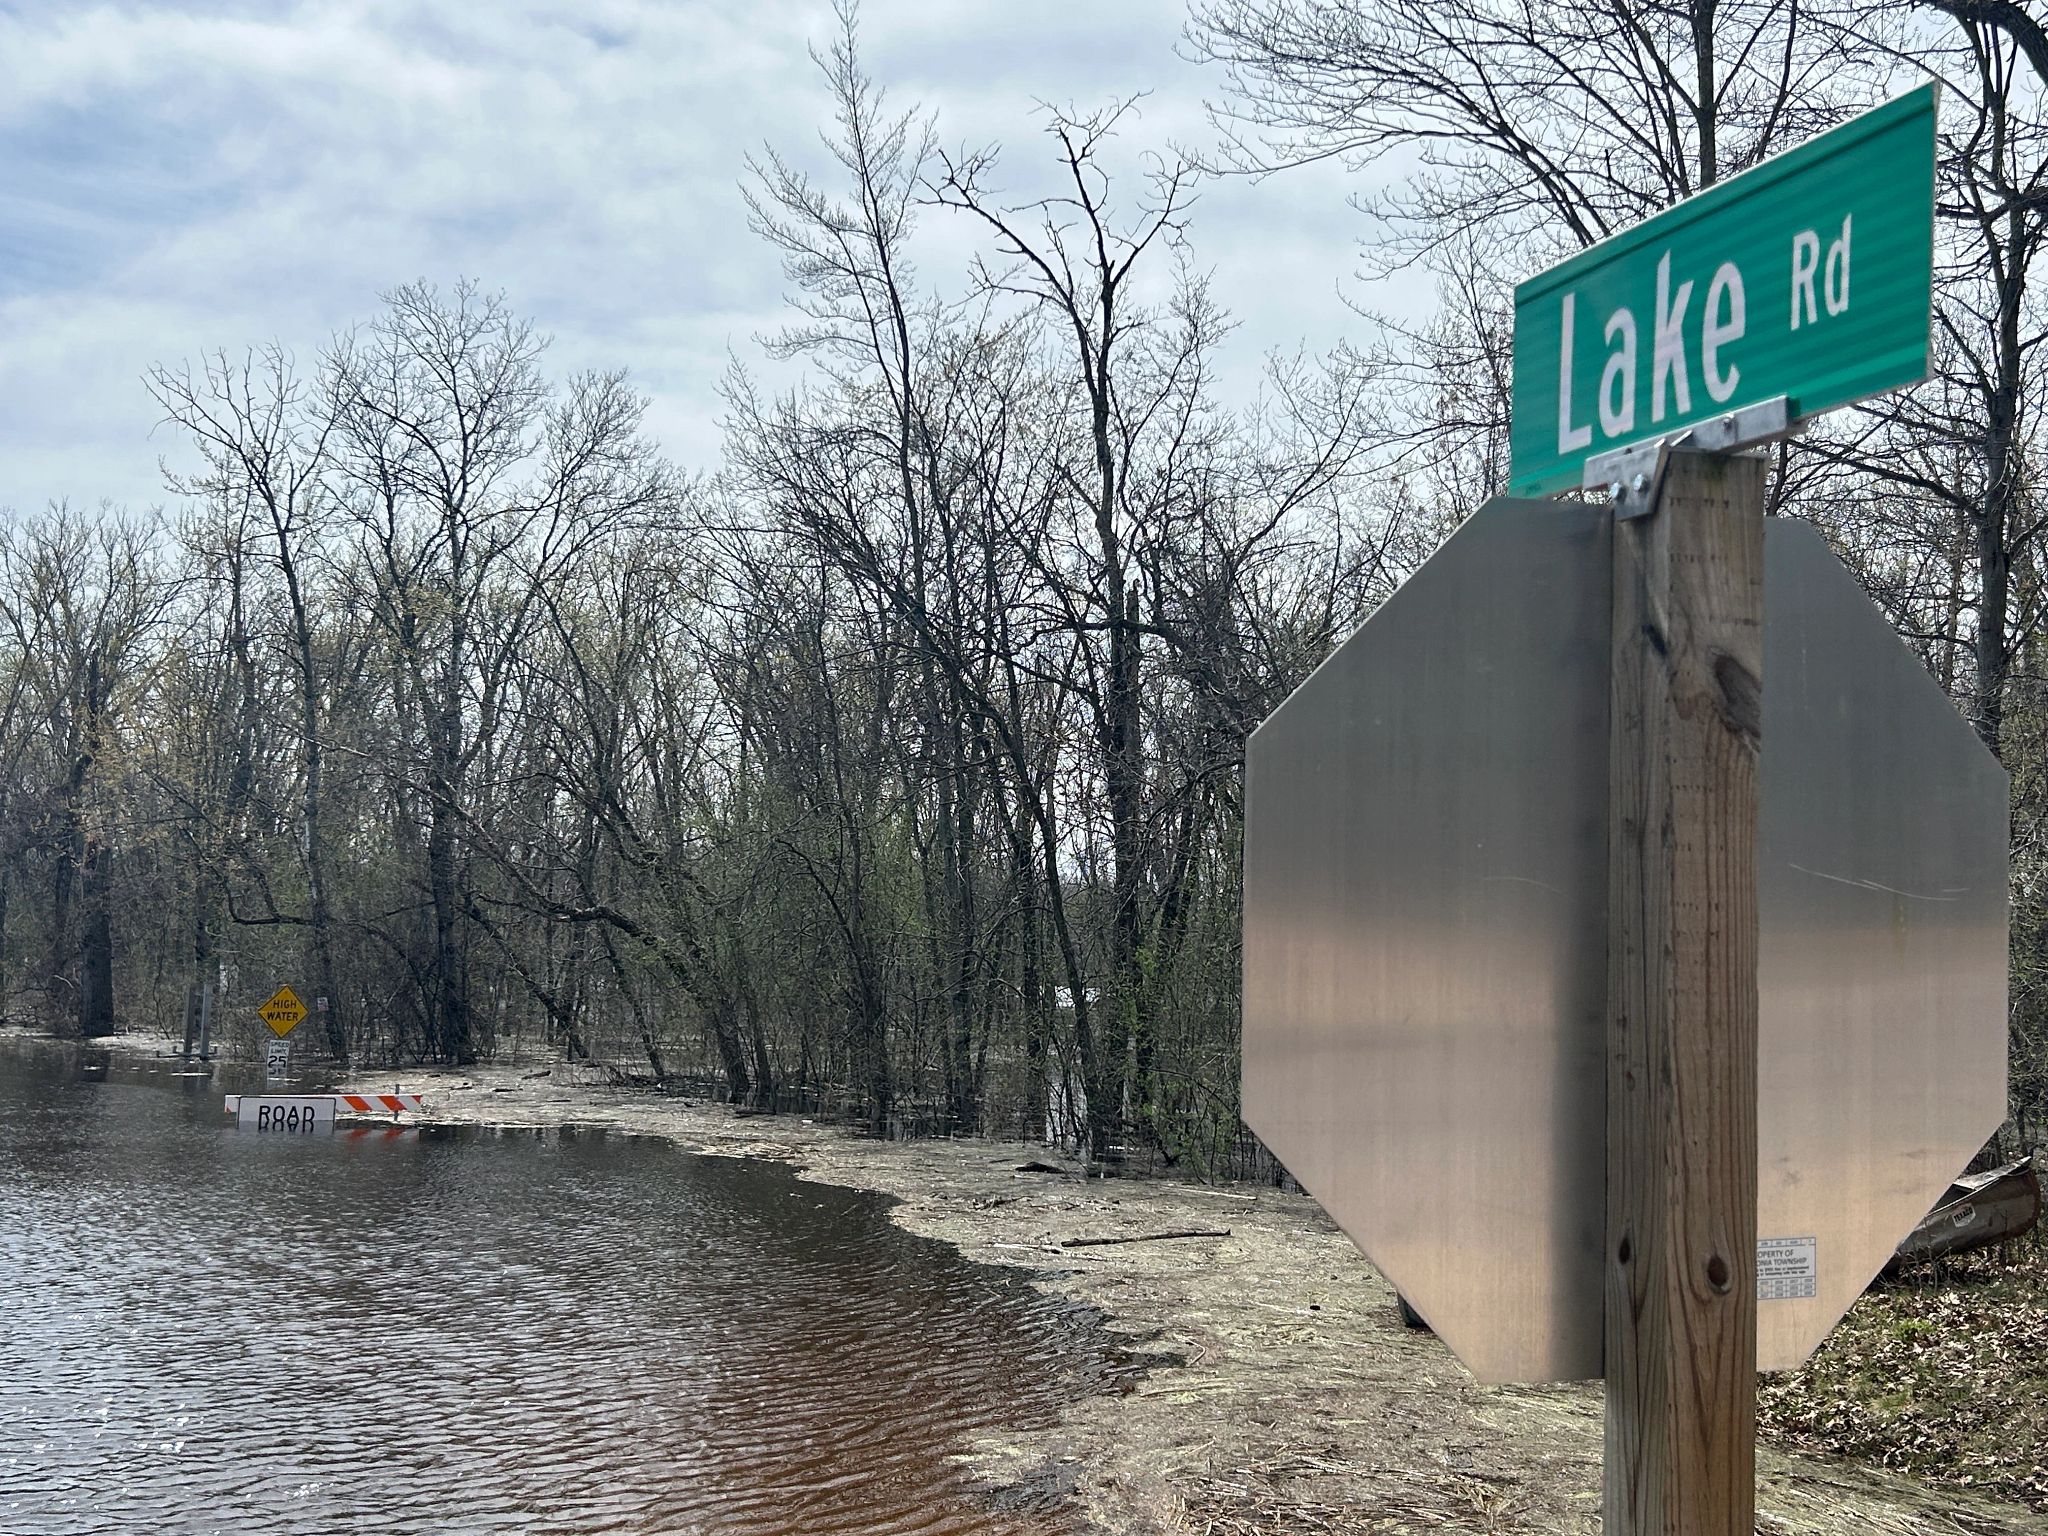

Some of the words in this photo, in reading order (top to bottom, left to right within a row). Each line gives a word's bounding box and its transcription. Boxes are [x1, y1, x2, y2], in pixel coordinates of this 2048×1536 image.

[1558, 248, 1746, 455] Lake
[1790, 212, 1852, 331] Rd
[272, 999, 297, 1010] HIGH
[266, 1011, 299, 1022] WATER
[268, 1055, 287, 1068] 25
[258, 1105, 315, 1122] ROAD
[1757, 1250, 1783, 1258] OPERTY
[1784, 1249, 1794, 1257] OF
[1774, 1257, 1807, 1265] TOWNSHIP
